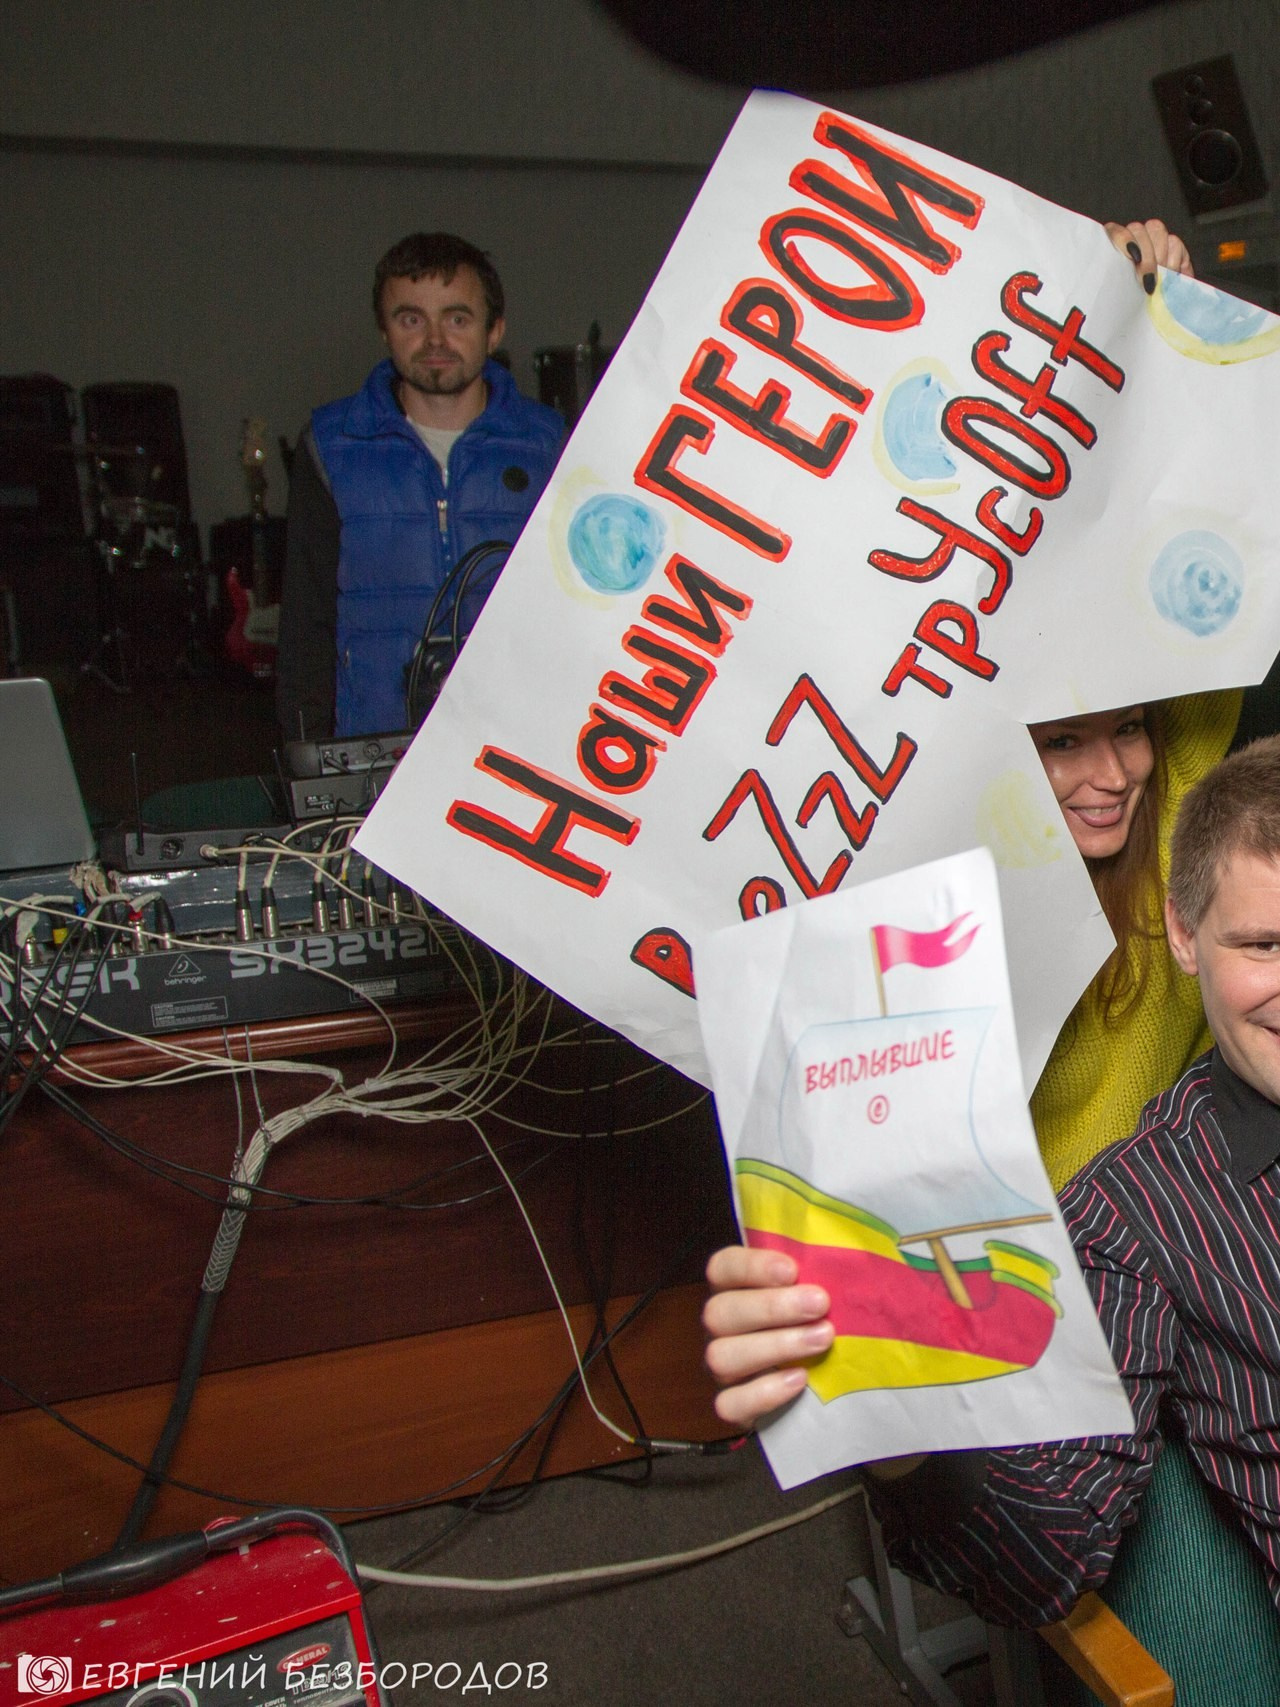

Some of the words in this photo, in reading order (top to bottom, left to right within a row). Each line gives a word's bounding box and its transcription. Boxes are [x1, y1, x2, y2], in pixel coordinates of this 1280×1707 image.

[634, 111, 985, 563] ГЕРОИ
[163, 974, 208, 987] behringer
[229, 927, 428, 979] SX3242
[804, 1028, 957, 1095] ВЫПЛЫВШИЕ
